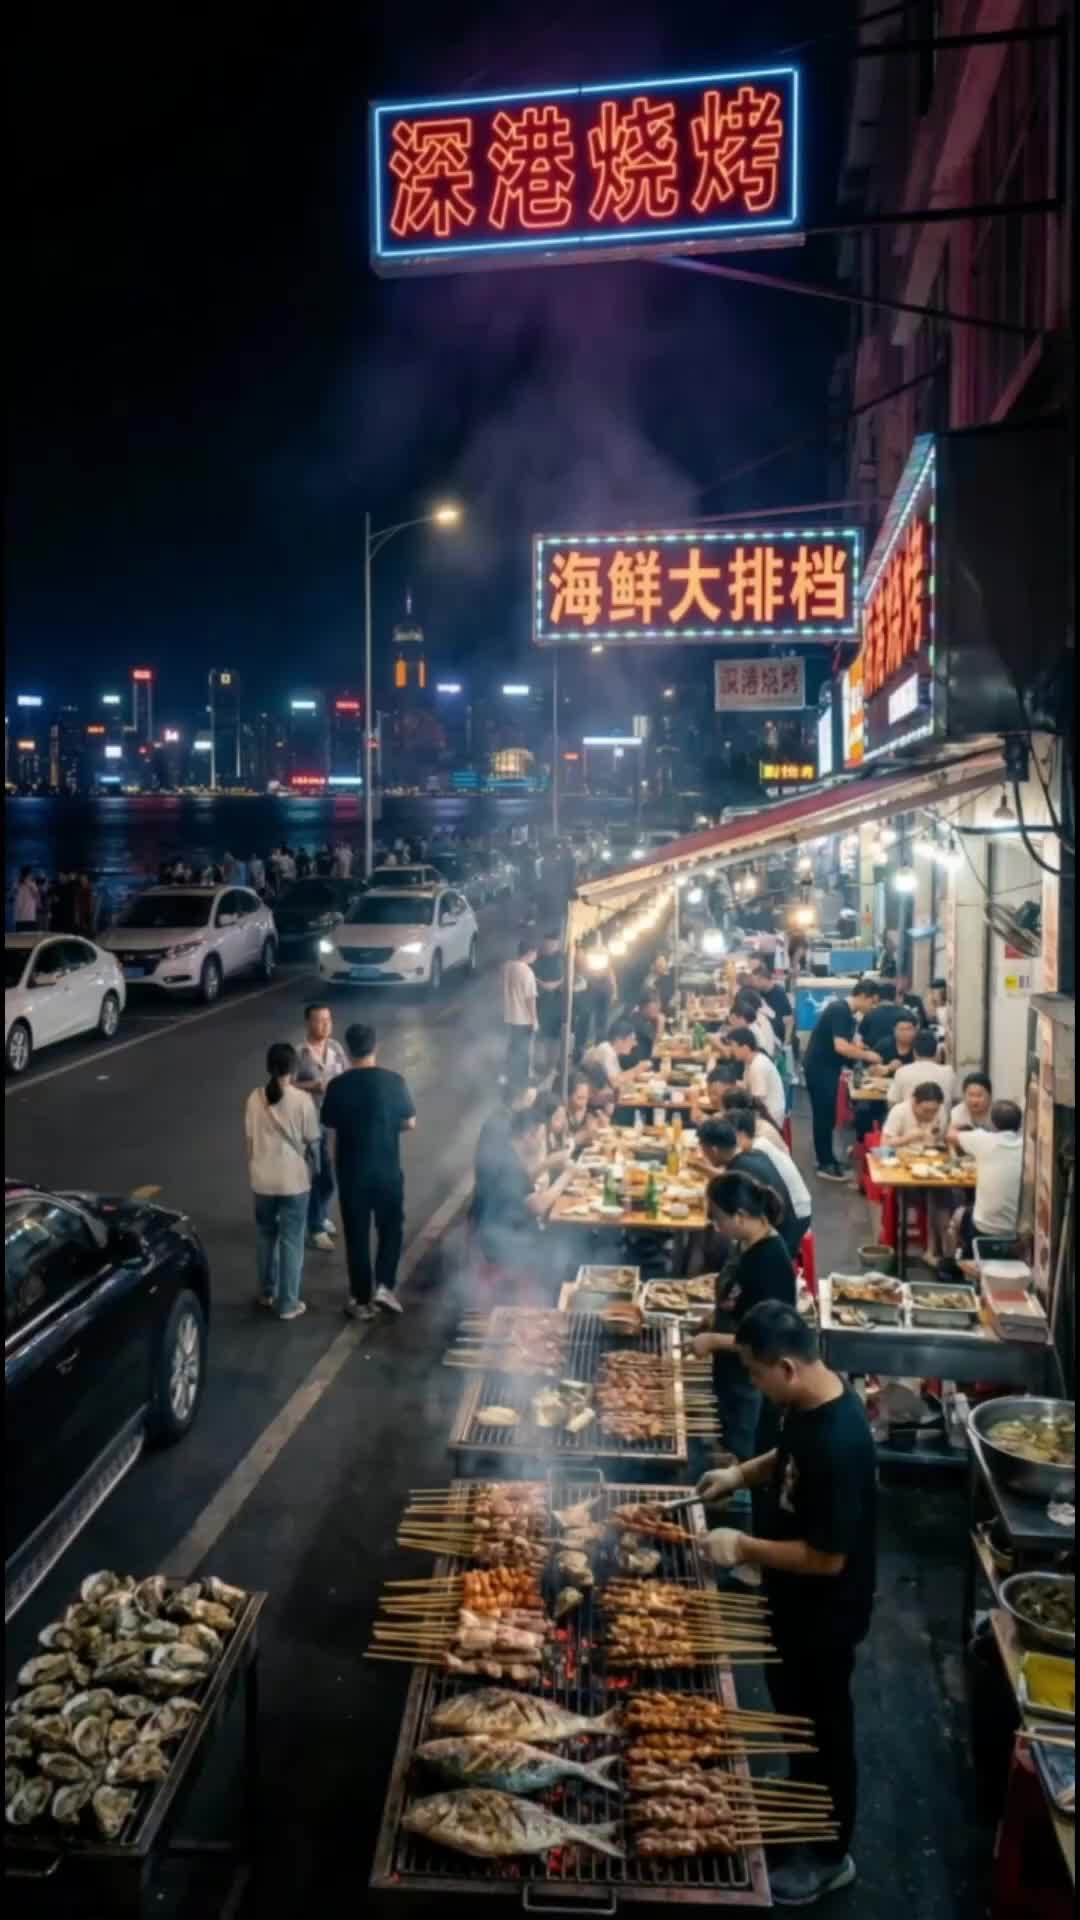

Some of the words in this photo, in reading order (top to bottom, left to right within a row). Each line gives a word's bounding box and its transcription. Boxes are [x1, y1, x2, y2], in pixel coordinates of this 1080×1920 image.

[389, 87, 783, 236] 深港烧烤
[549, 545, 847, 625] 海鲜大排档
